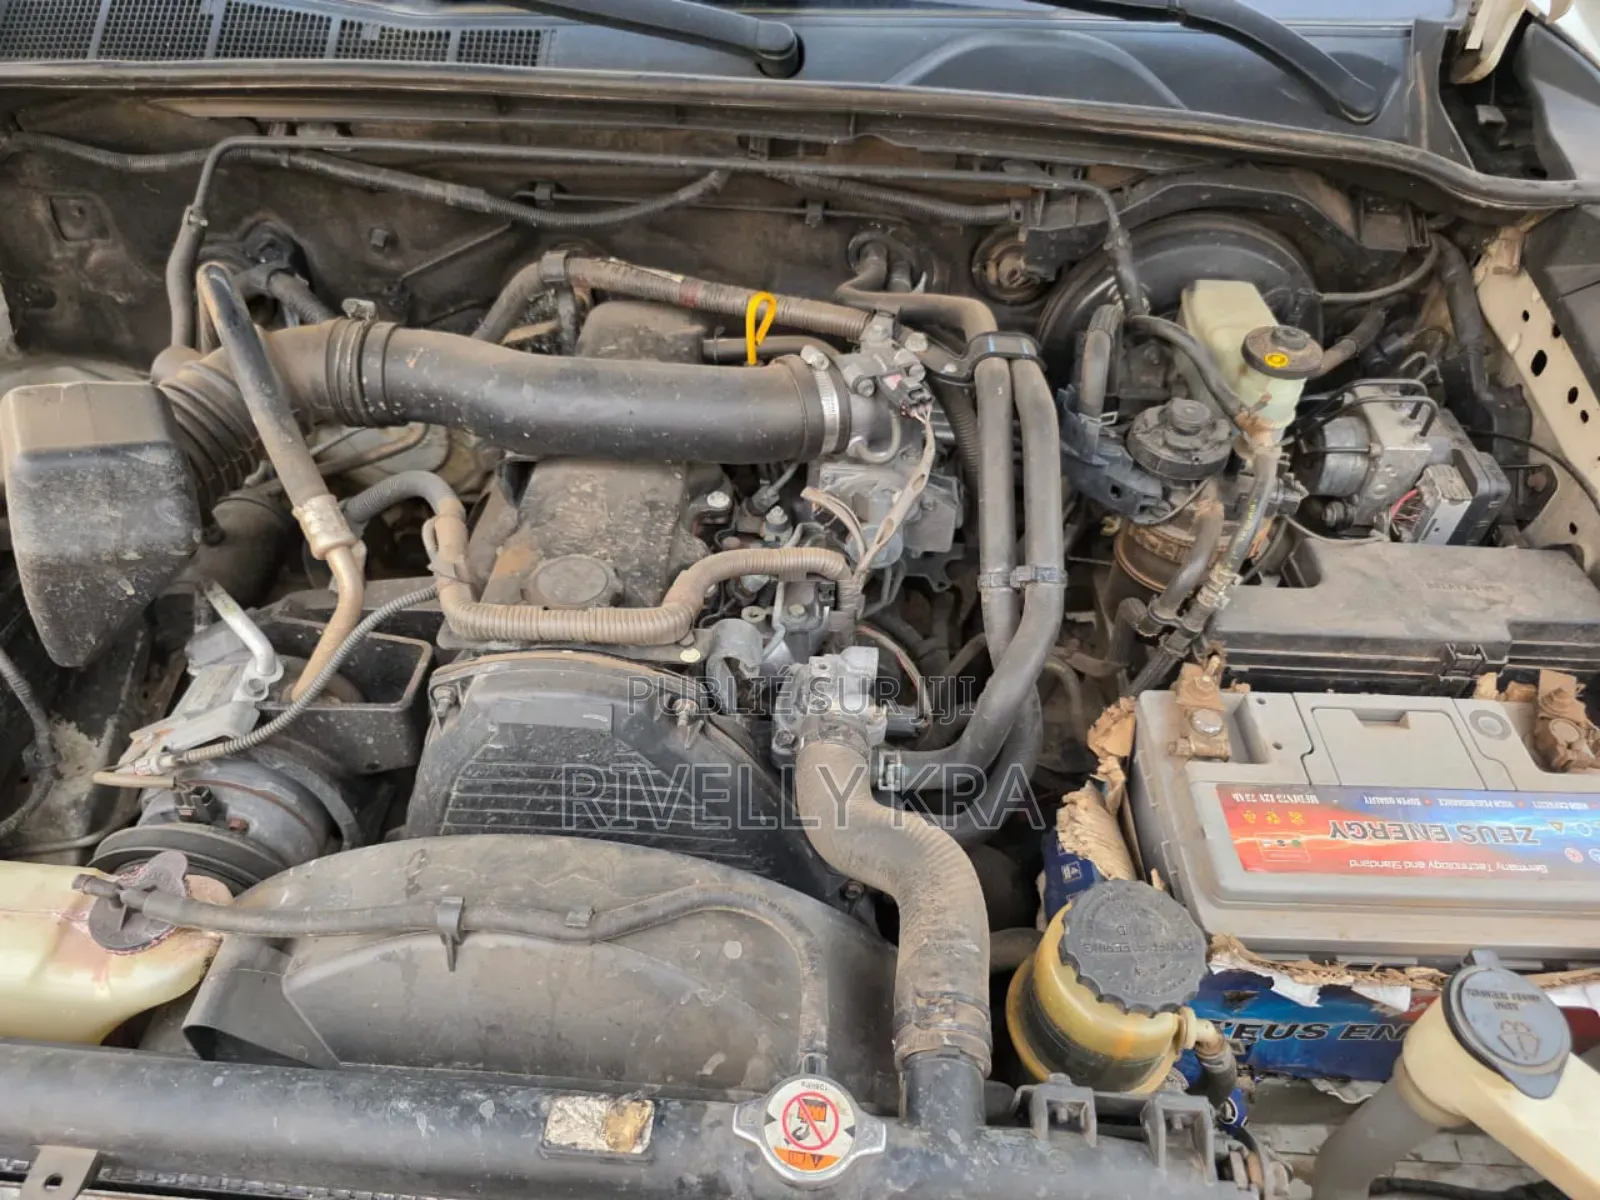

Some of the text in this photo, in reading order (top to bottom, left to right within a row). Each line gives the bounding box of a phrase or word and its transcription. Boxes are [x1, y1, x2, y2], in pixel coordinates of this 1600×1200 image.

[1329, 819, 1541, 846] ZEUS ENERGY
[1349, 859, 1548, 874] Germany Technology and Standard
